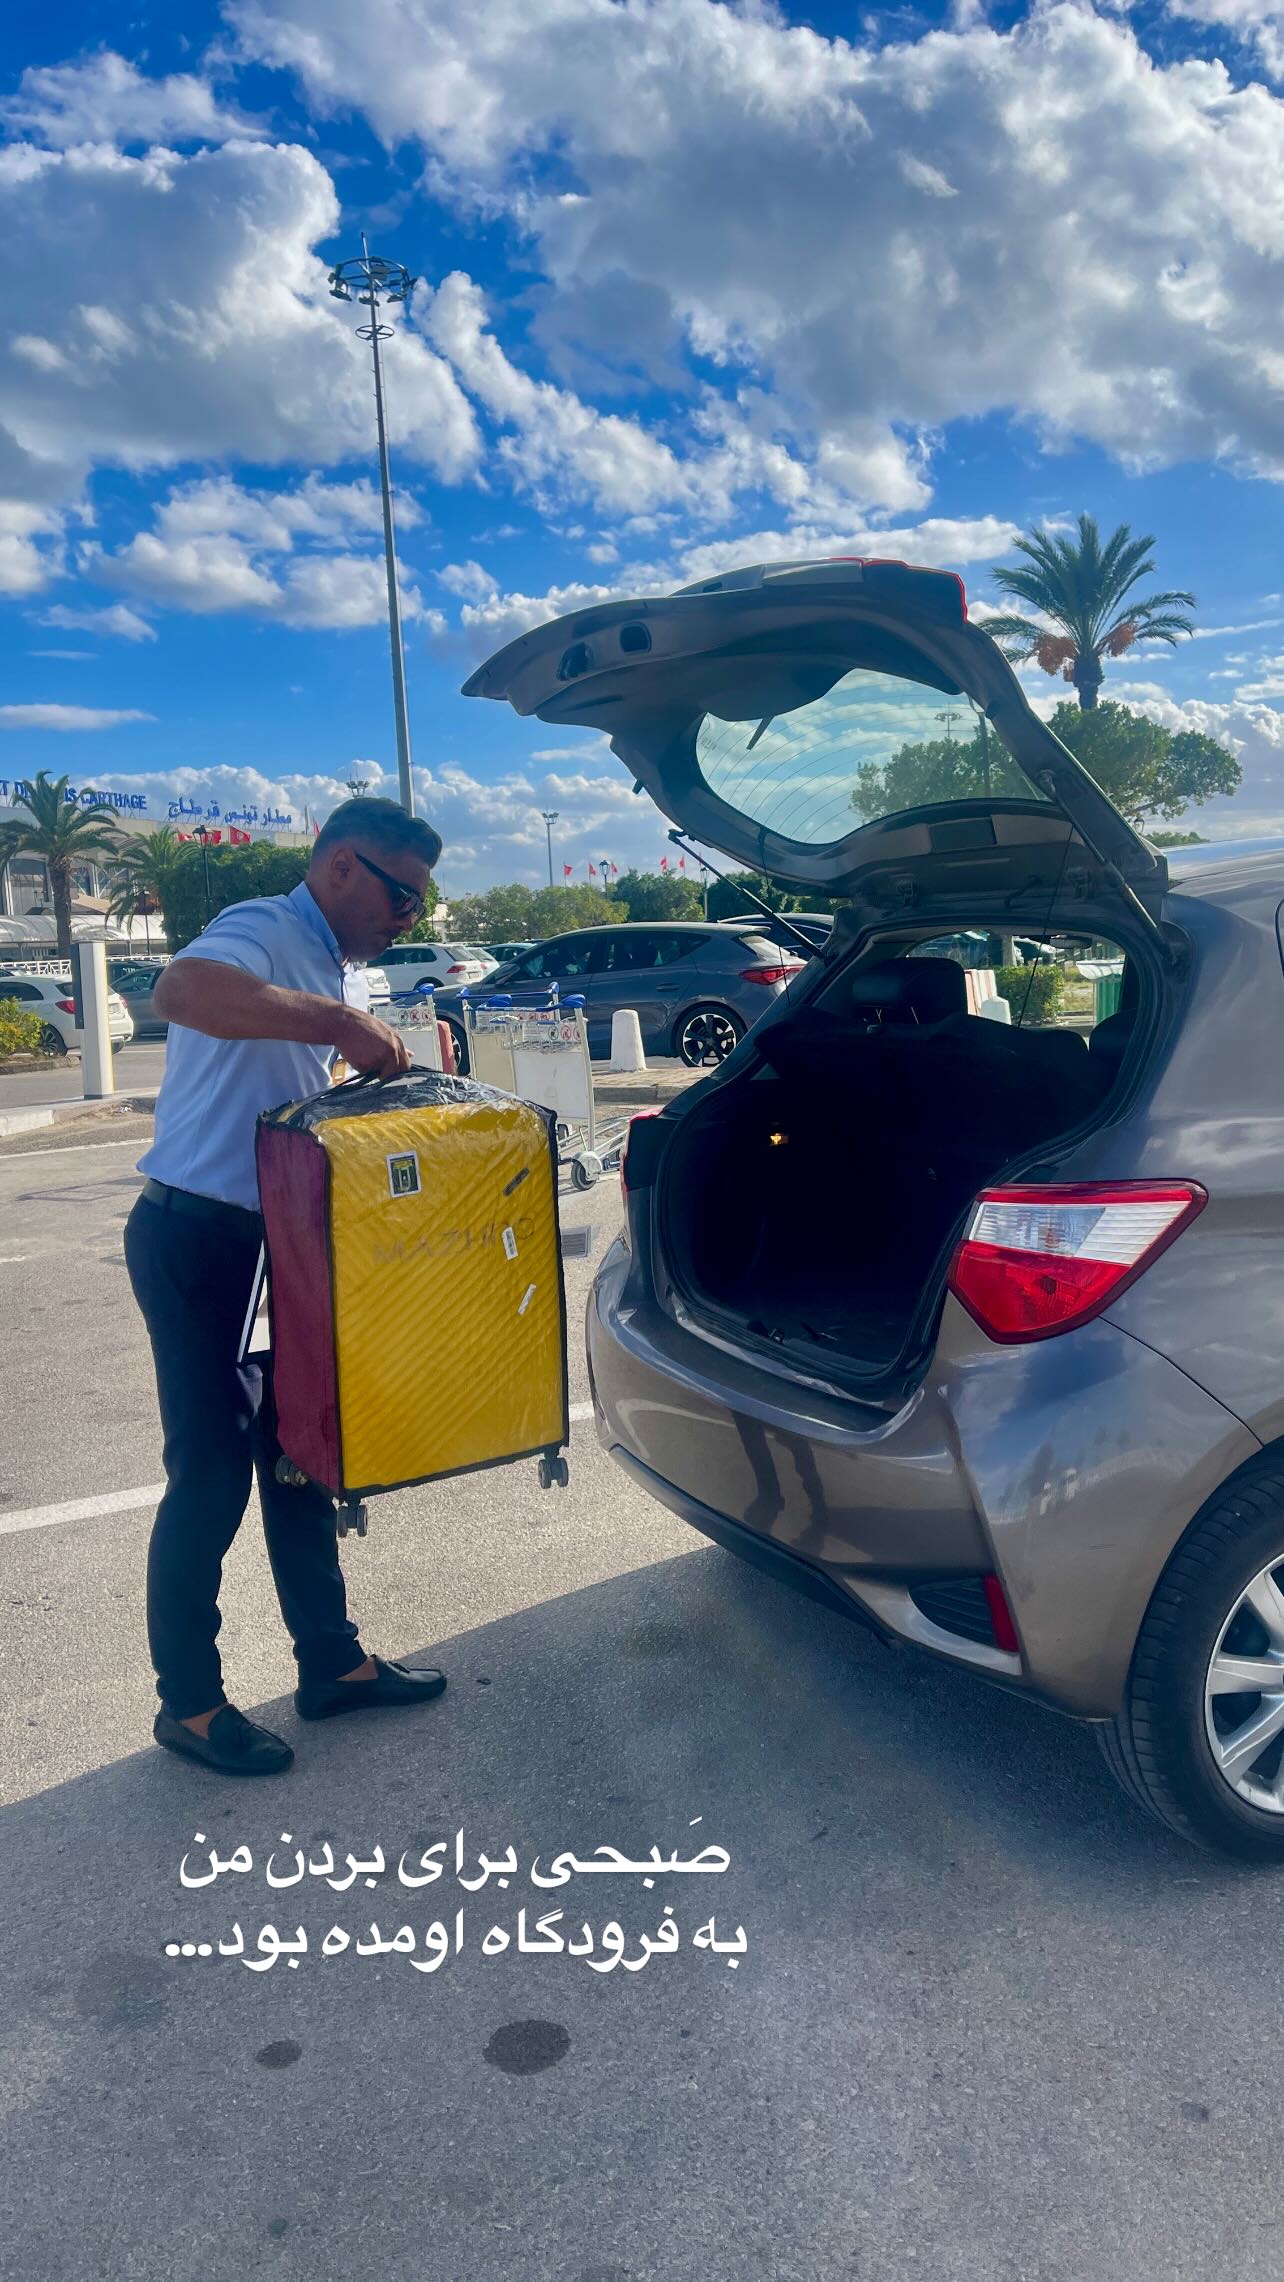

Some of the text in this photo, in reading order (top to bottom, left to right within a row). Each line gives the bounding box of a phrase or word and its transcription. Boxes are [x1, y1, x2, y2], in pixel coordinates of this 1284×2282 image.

[81, 790, 148, 810] CARTHAGE
[168, 796, 292, 826] مطار تونس قرطاج
